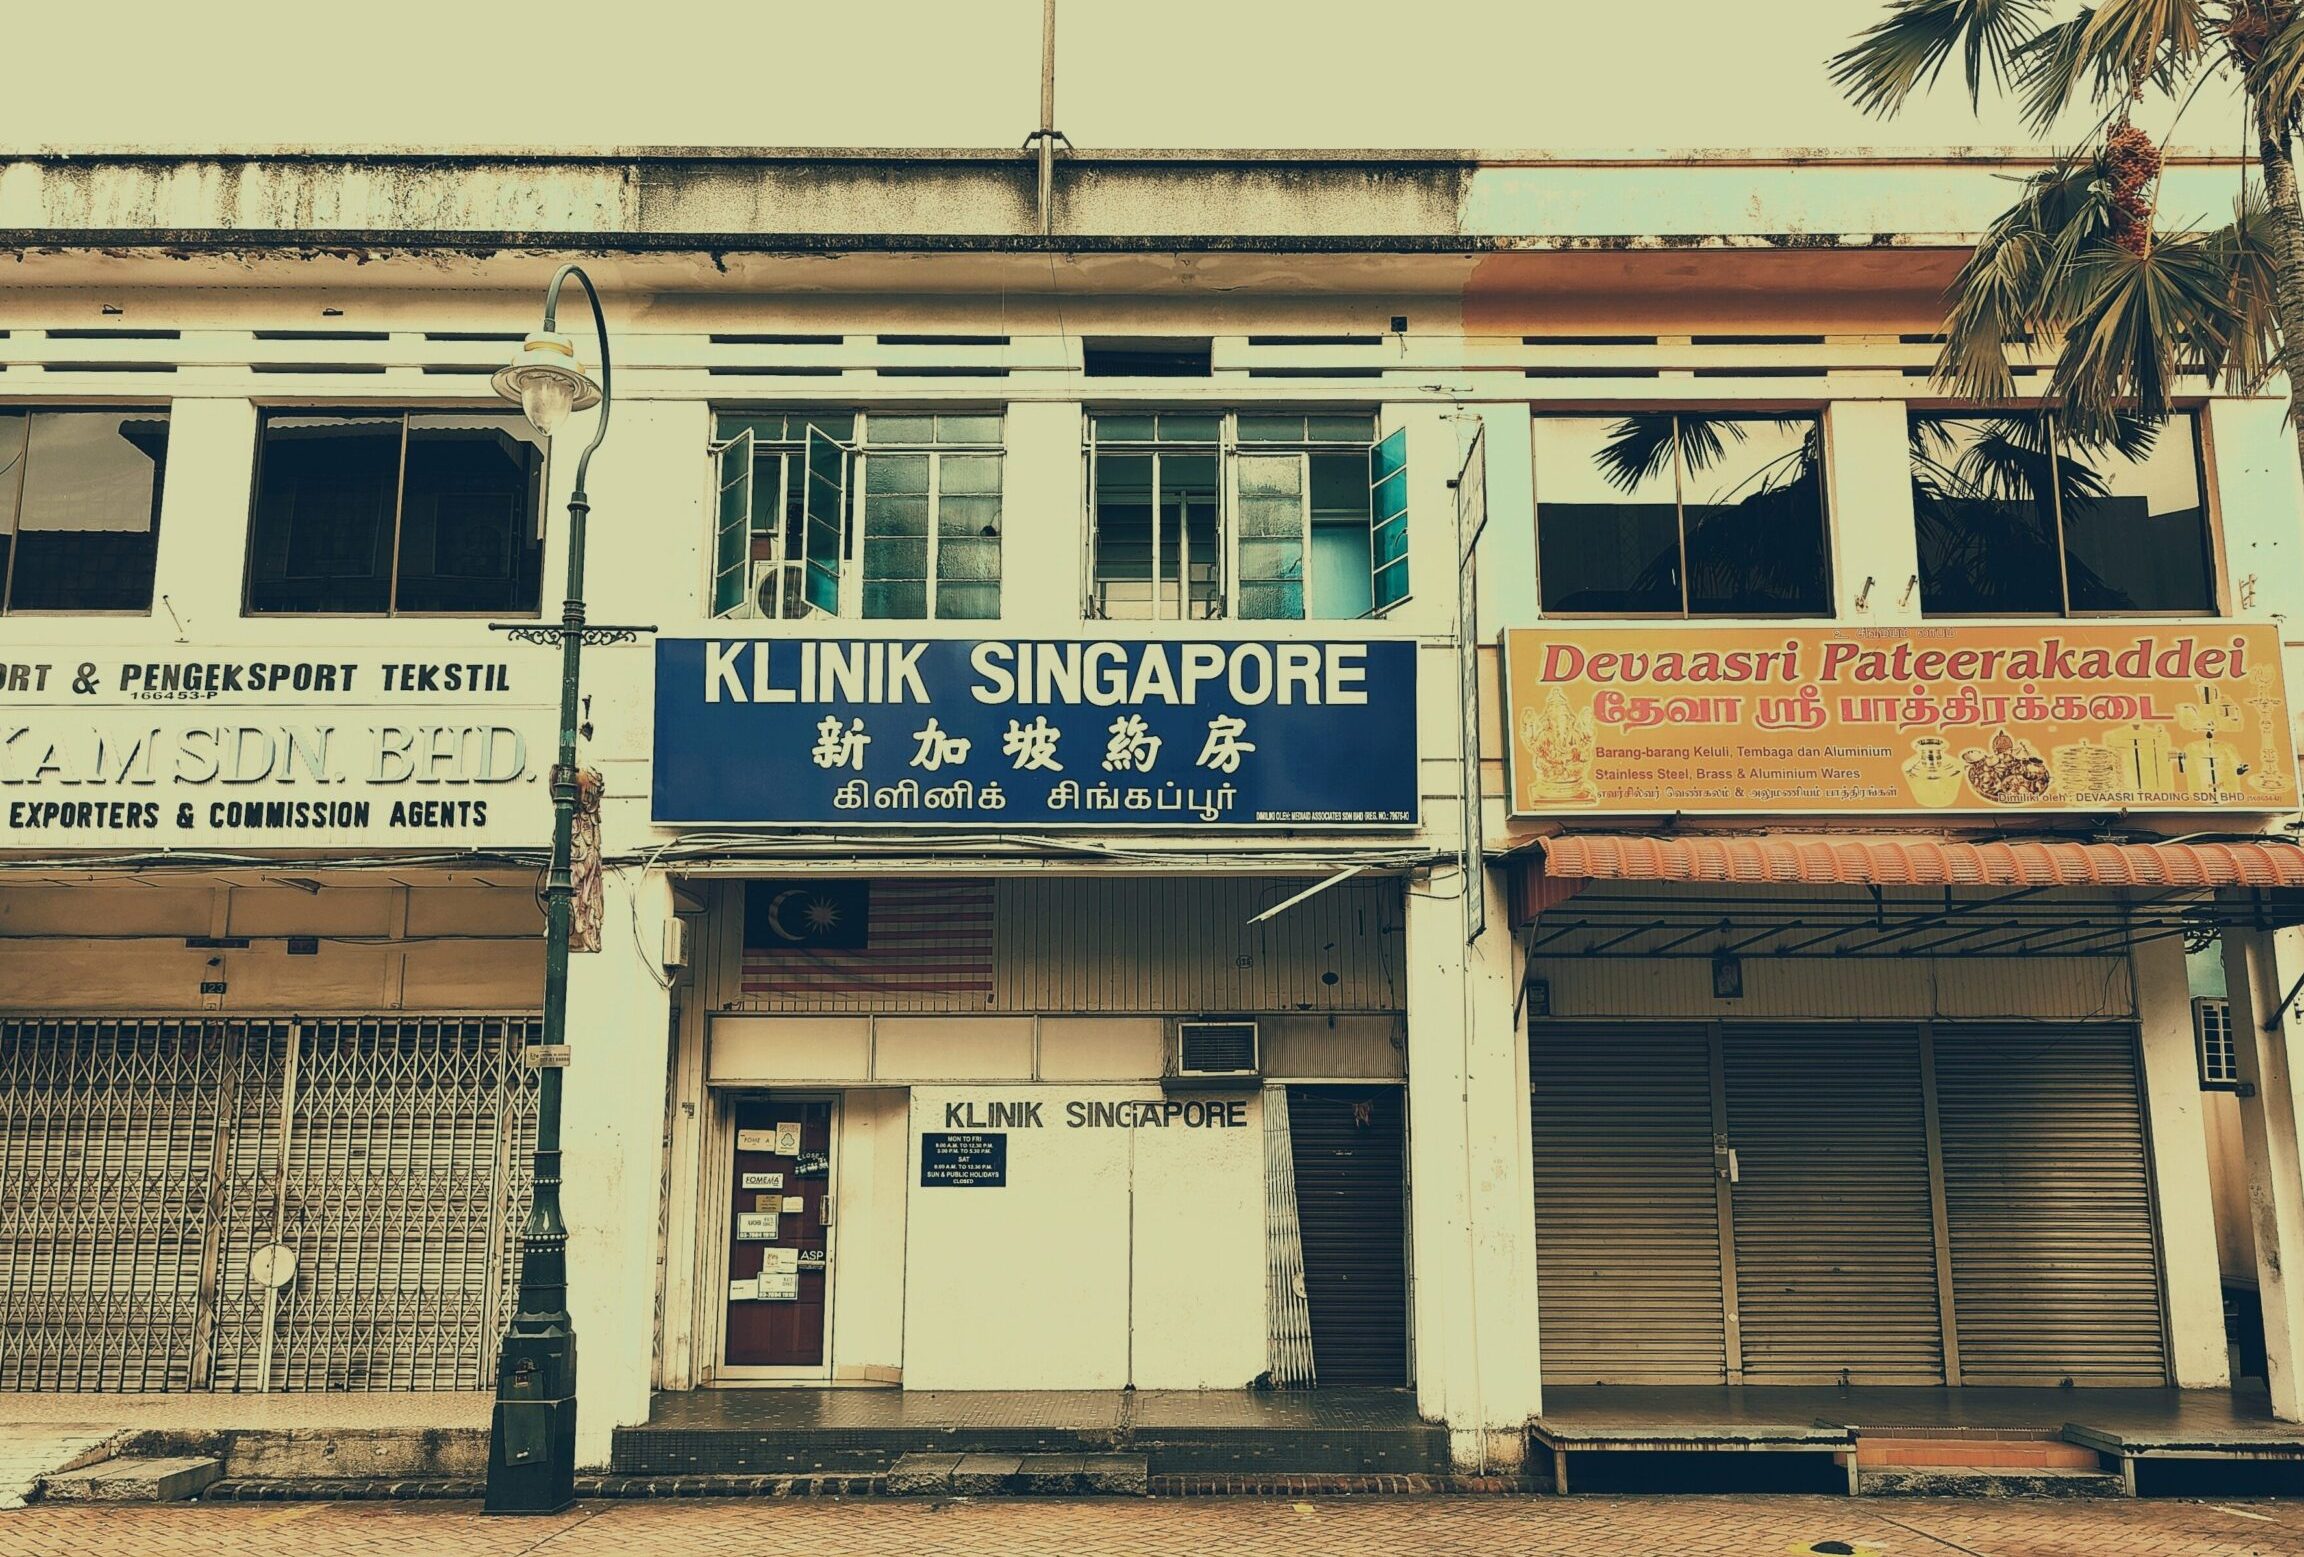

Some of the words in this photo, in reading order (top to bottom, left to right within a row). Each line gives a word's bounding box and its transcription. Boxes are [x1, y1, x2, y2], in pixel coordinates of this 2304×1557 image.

[704, 642, 931, 703] KLINIK
[970, 641, 1367, 705] SINGAPORE
[1540, 641, 1799, 682] Devaasri
[1820, 637, 2246, 681] Pateerakaddei
[72, 662, 100, 694] &
[120, 662, 357, 691] PENGEKSPORT
[382, 663, 510, 691] TEKSTIL
[131, 691, 218, 700] 166453-P
[1593, 691, 1741, 734] தேவா
[1841, 684, 2174, 730] பாத்திரக்கடை
[173, 725, 345, 785] SDN.
[365, 725, 537, 785] BHD.
[1596, 747, 1689, 760] Barang-barang
[1694, 746, 1733, 758] Keluli,
[1738, 746, 1793, 759] Tembaga
[1797, 746, 1820, 757] dan
[1824, 746, 1892, 757] Aluminium
[1595, 768, 1653, 780] Stainless
[1657, 768, 1692, 781] Steel,
[1697, 768, 1733, 780] Brass
[1737, 768, 1746, 779] &
[1750, 768, 1817, 779] Aluminium
[1821, 768, 1860, 779] Wares
[832, 779, 1006, 810] கிளினிக்
[1047, 779, 1237, 821] சிங்கப்பூர்
[1999, 791, 2039, 802] Dimiliki
[2077, 792, 2134, 802] DEVAASRI
[2137, 792, 2189, 802] TRADING
[2193, 791, 2217, 801] SDN
[2220, 791, 2244, 801] BHD
[9, 801, 160, 829] EXPORTERS
[176, 801, 194, 829] &
[209, 801, 369, 829] COMMISSION
[390, 801, 487, 828] AGENTS
[203, 983, 225, 993] 123
[946, 1102, 1043, 1128] KLINIK
[1066, 1101, 1247, 1128] SINGAPORE
[801, 1250, 824, 1260] ASP
